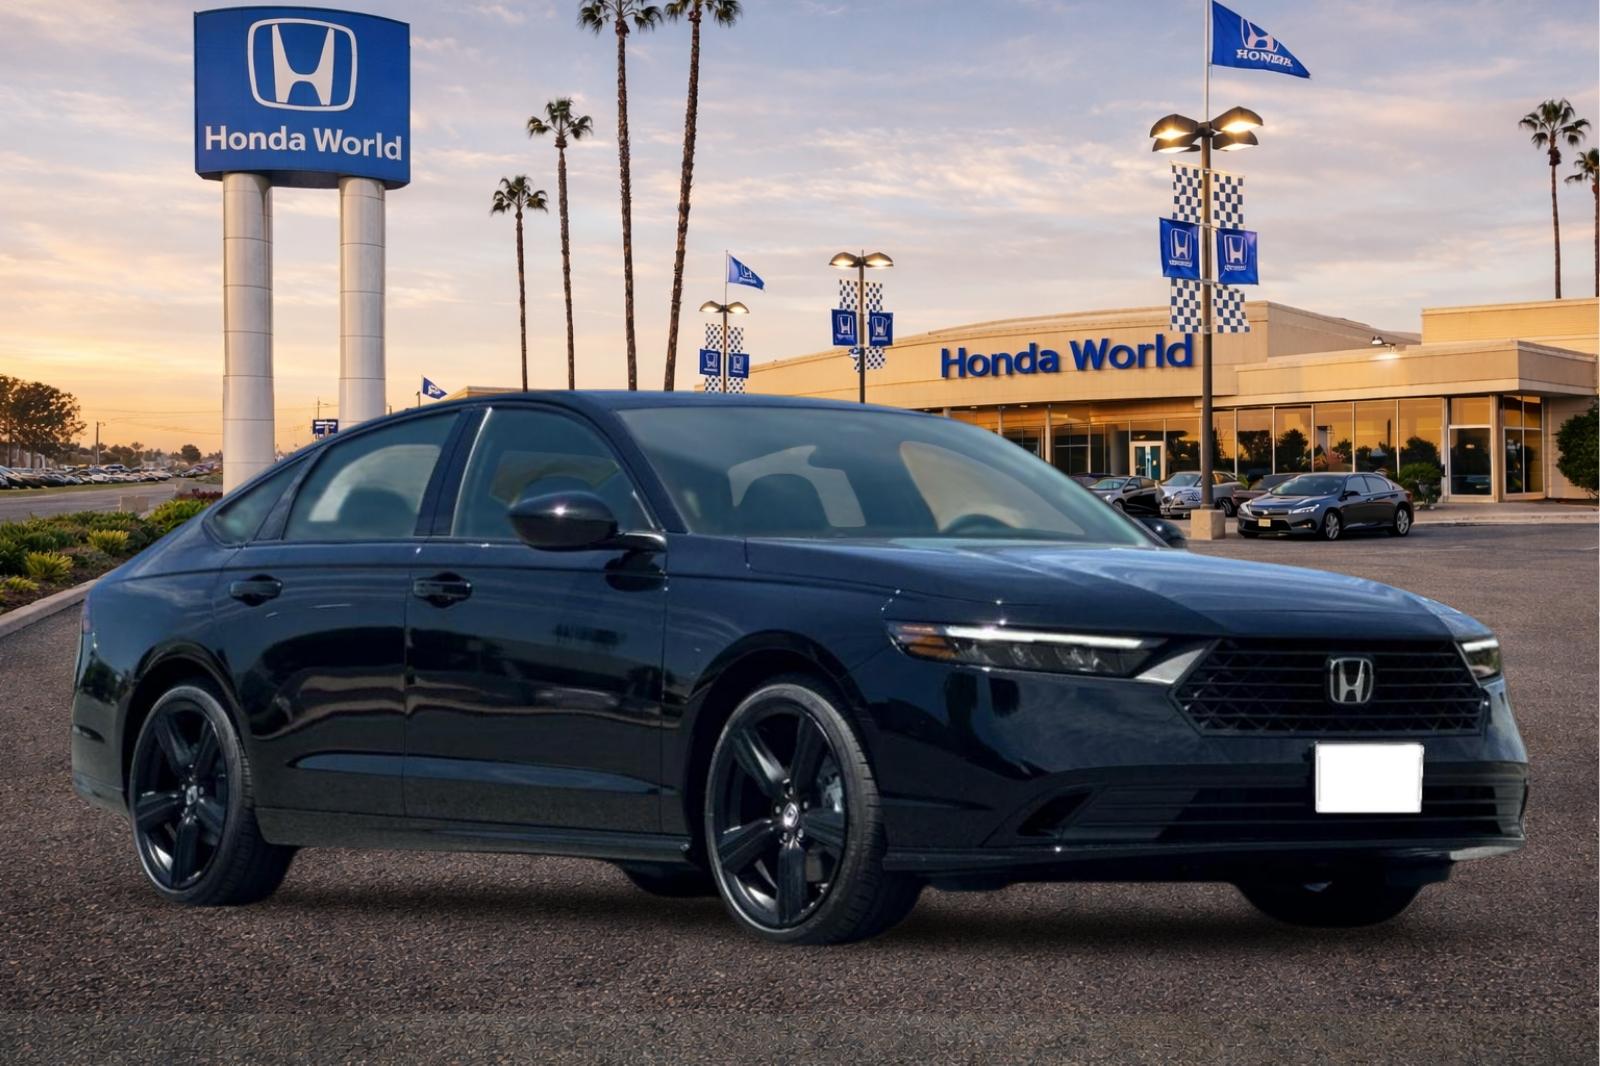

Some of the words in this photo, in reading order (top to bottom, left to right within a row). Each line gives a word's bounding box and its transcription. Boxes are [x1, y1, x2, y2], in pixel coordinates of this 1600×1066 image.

[205, 125, 306, 151] Honda
[313, 127, 402, 161] World
[940, 342, 1061, 379] Honda
[1069, 333, 1194, 372] World
